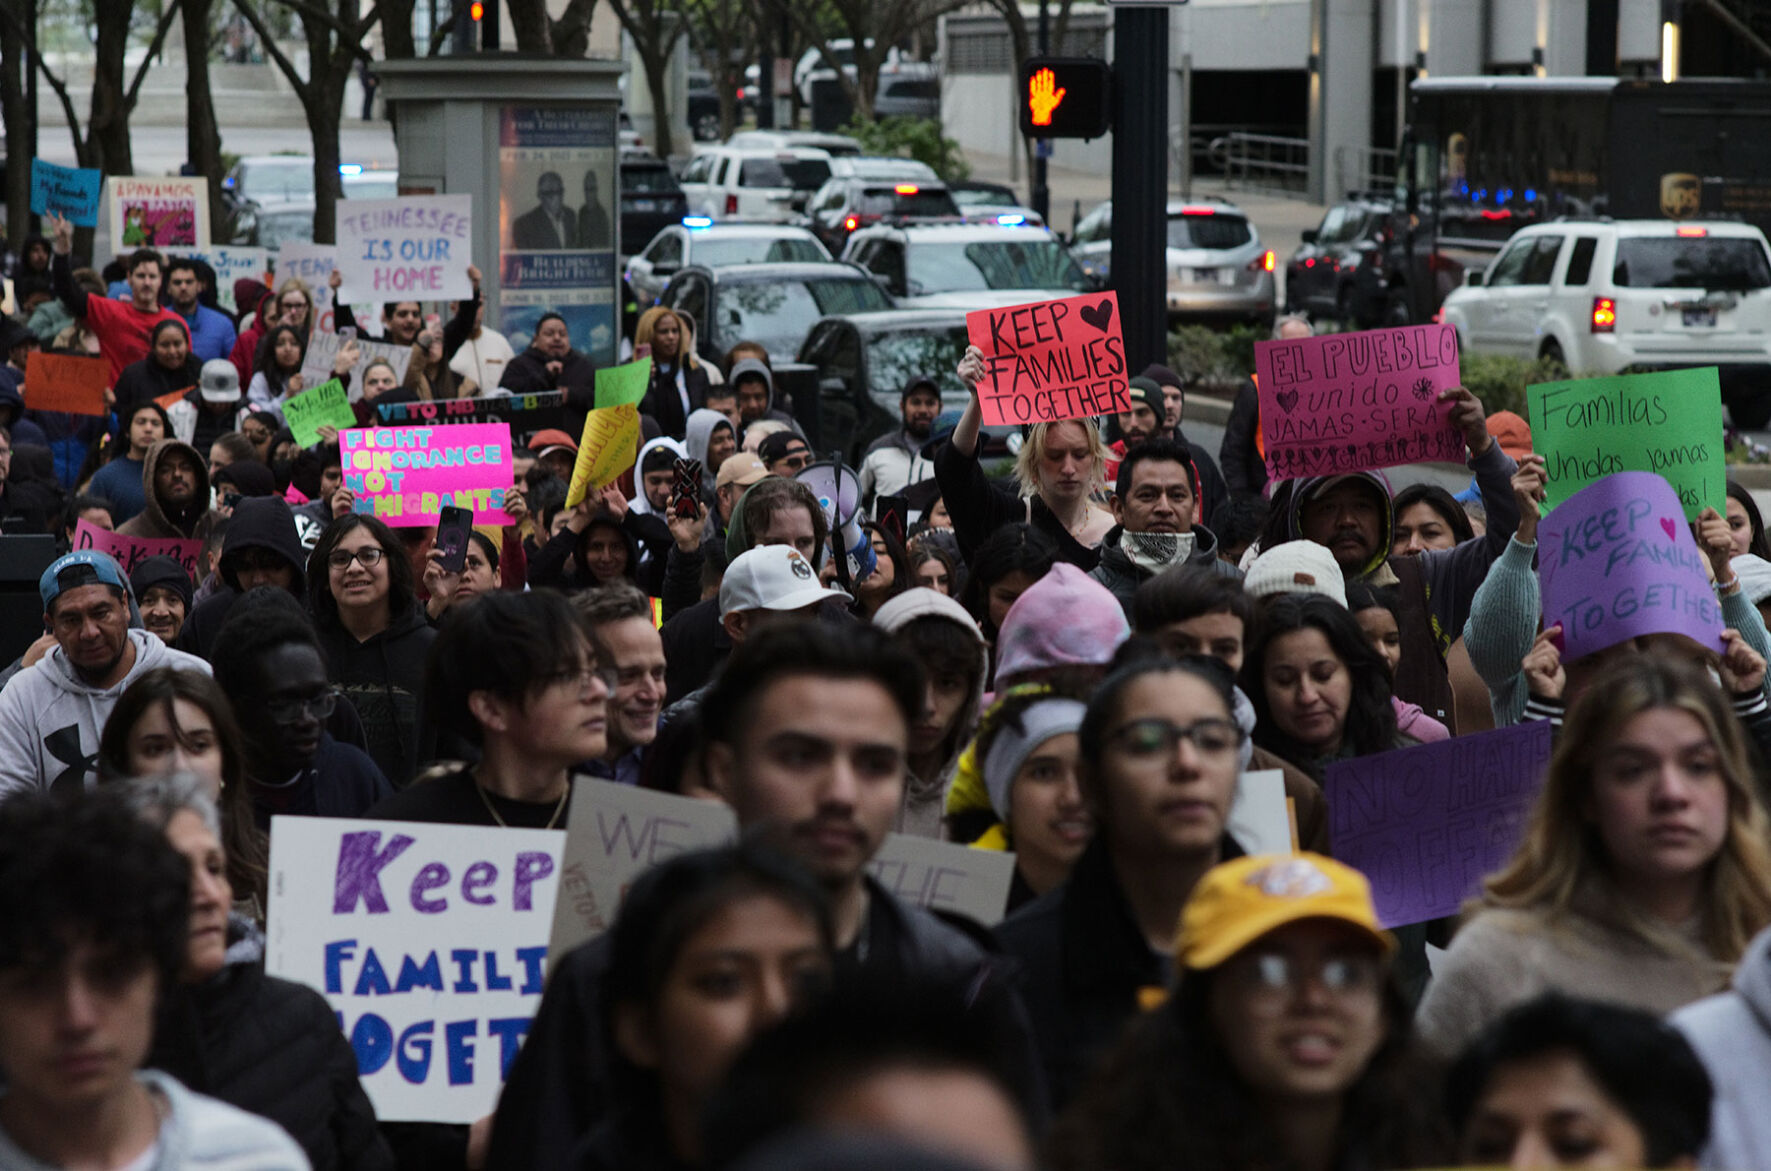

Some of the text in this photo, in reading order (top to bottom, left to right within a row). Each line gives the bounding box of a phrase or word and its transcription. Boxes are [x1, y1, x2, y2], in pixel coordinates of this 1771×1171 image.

[344, 207, 469, 238] TENNESSEE
[362, 238, 451, 261] IS OUR
[374, 266, 443, 291] HOME
[990, 302, 1068, 356] KEEP
[986, 336, 1124, 394] FAMILIES
[1270, 327, 1456, 387] EL PUEBLO
[378, 402, 438, 422] VETO
[986, 380, 1131, 424] TOGETHER
[1308, 378, 1399, 413] unido
[1540, 387, 1668, 431] Familias
[346, 428, 433, 449] FIGHT
[1269, 412, 1354, 442] JAMAS
[342, 445, 502, 472] IGNORANCE
[1544, 447, 1624, 483] Unidas
[345, 471, 404, 494] NOT
[1561, 498, 1651, 568] KEEP
[597, 811, 691, 867] WE
